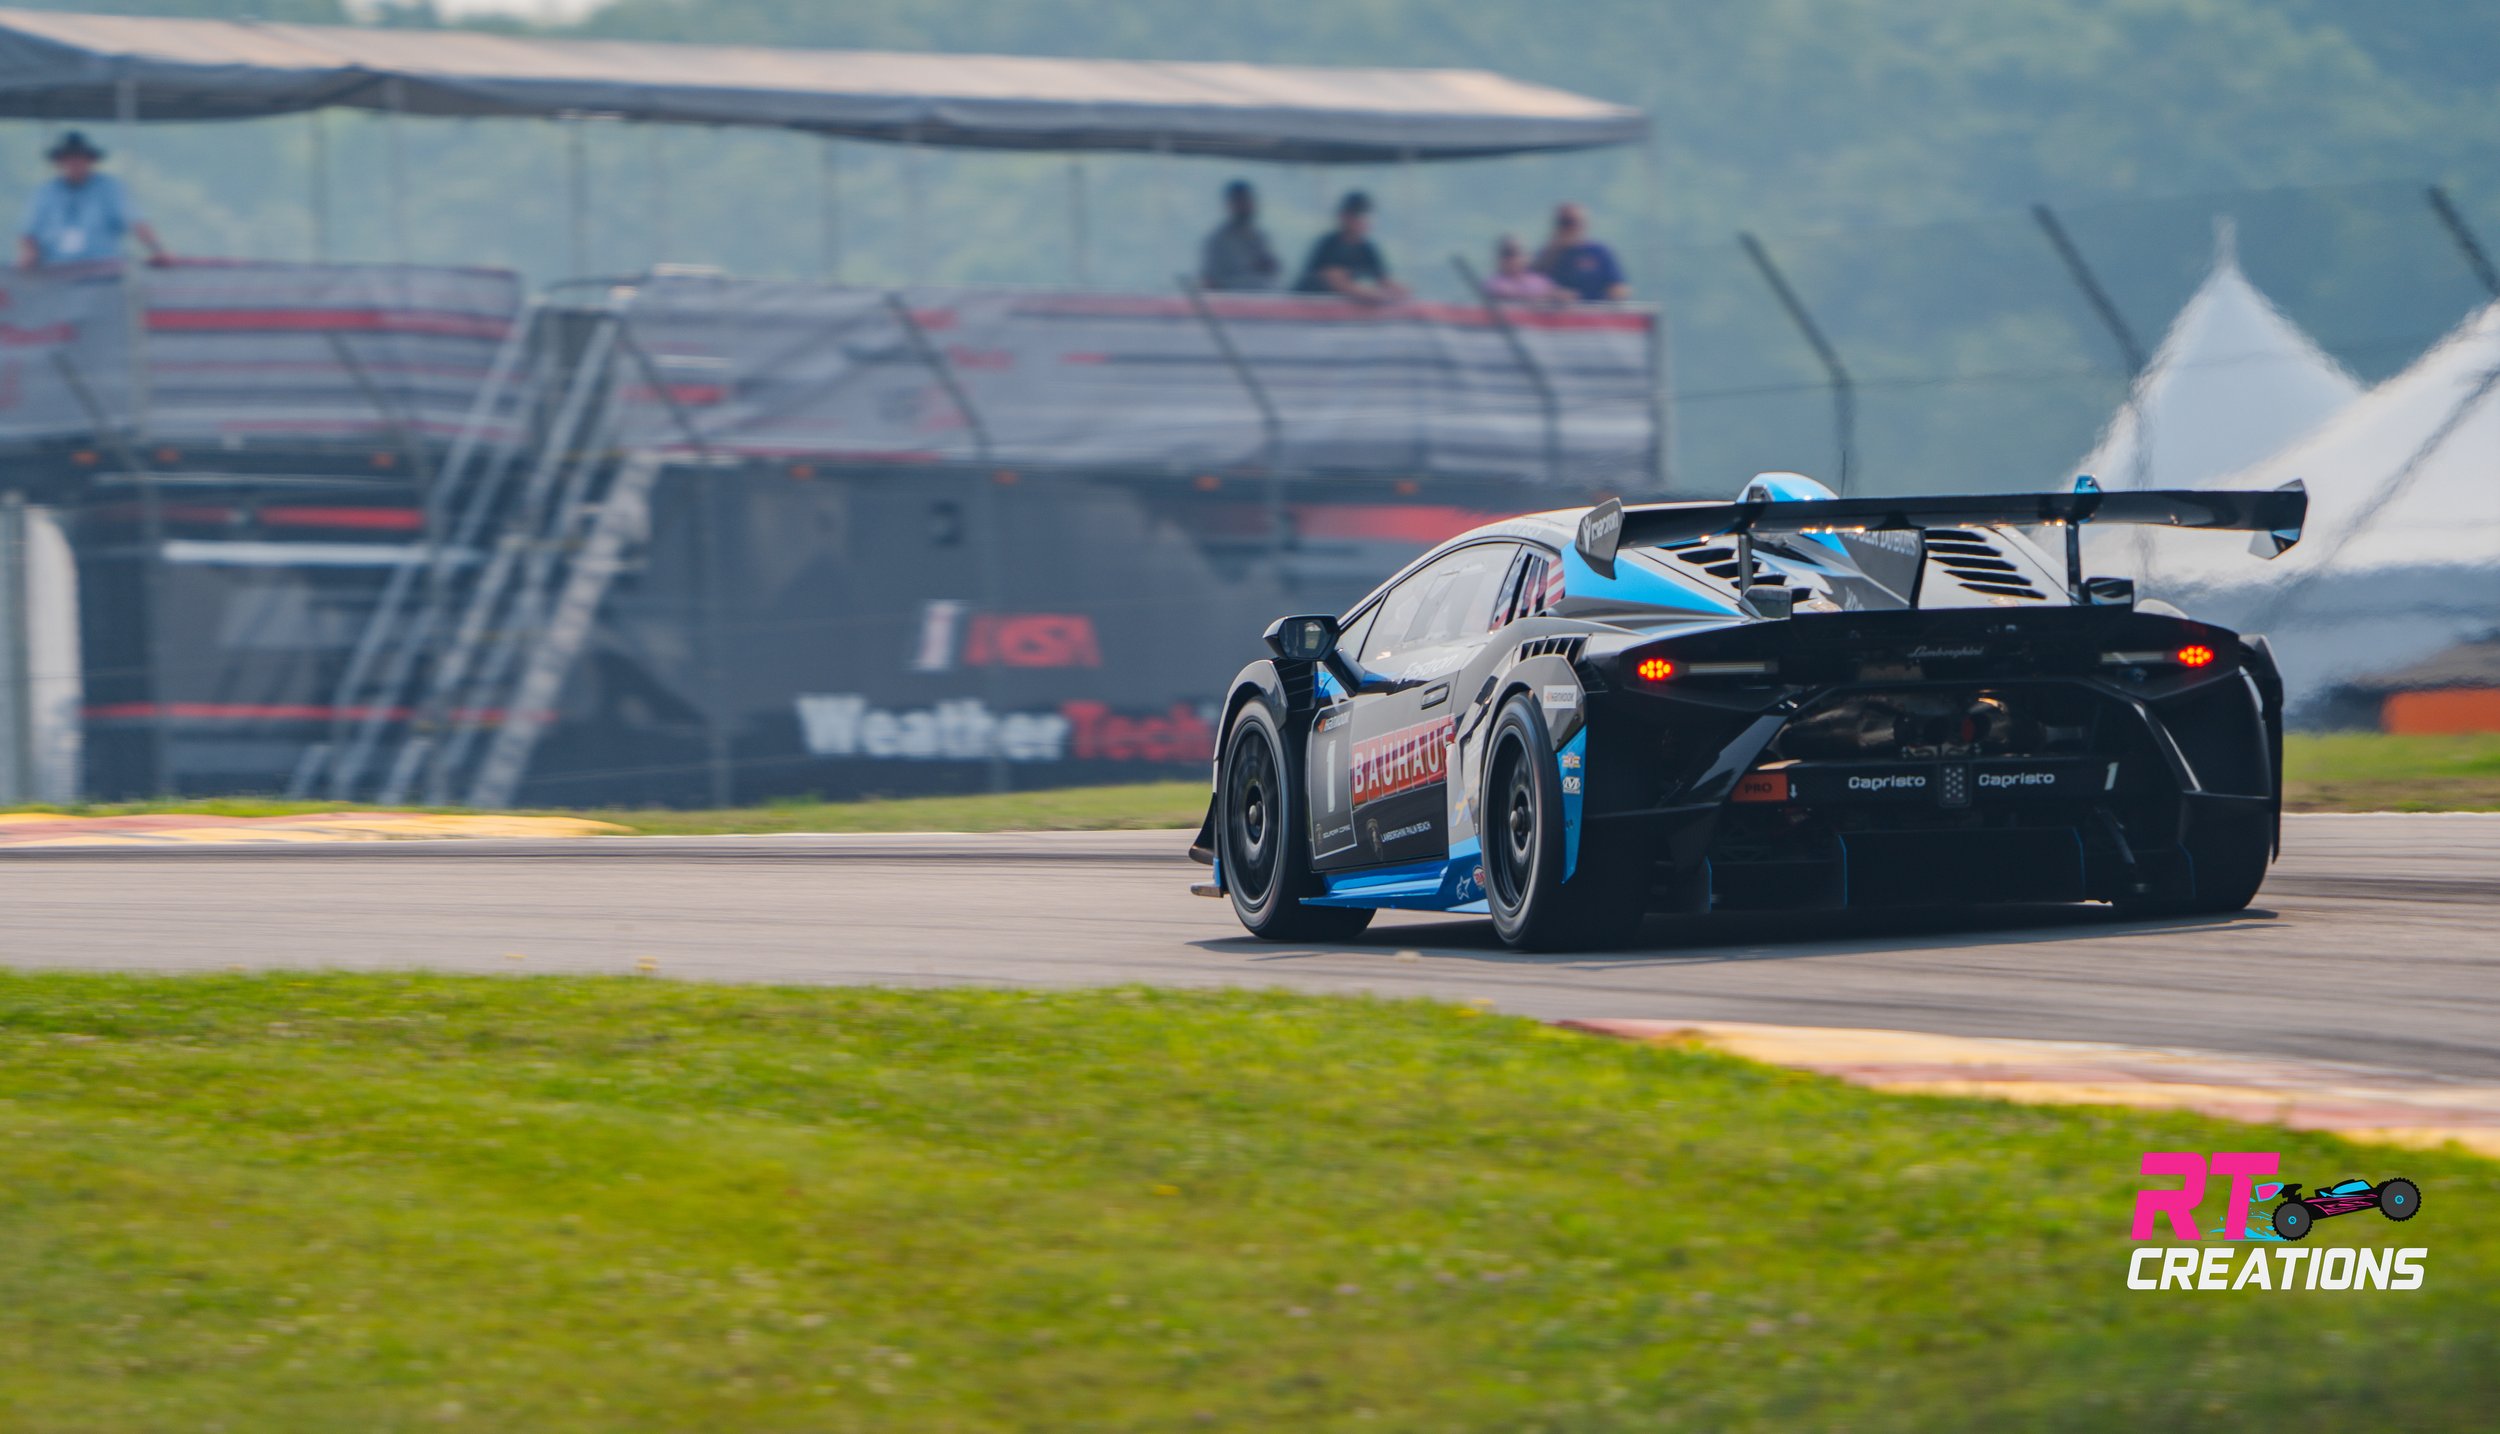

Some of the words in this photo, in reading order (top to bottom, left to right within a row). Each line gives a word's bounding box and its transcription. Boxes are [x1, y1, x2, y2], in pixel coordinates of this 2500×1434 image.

[1906, 645, 1985, 659] Lamborghini
[798, 694, 1213, 760] WeatherTech
[1327, 740, 1337, 813] 1
[1848, 775, 1926, 791] Capristo
[1978, 772, 2055, 788] Capristo
[2104, 762, 2119, 790] 1
[1744, 782, 1773, 794] PRO
[1416, 821, 1432, 833] BEACH
